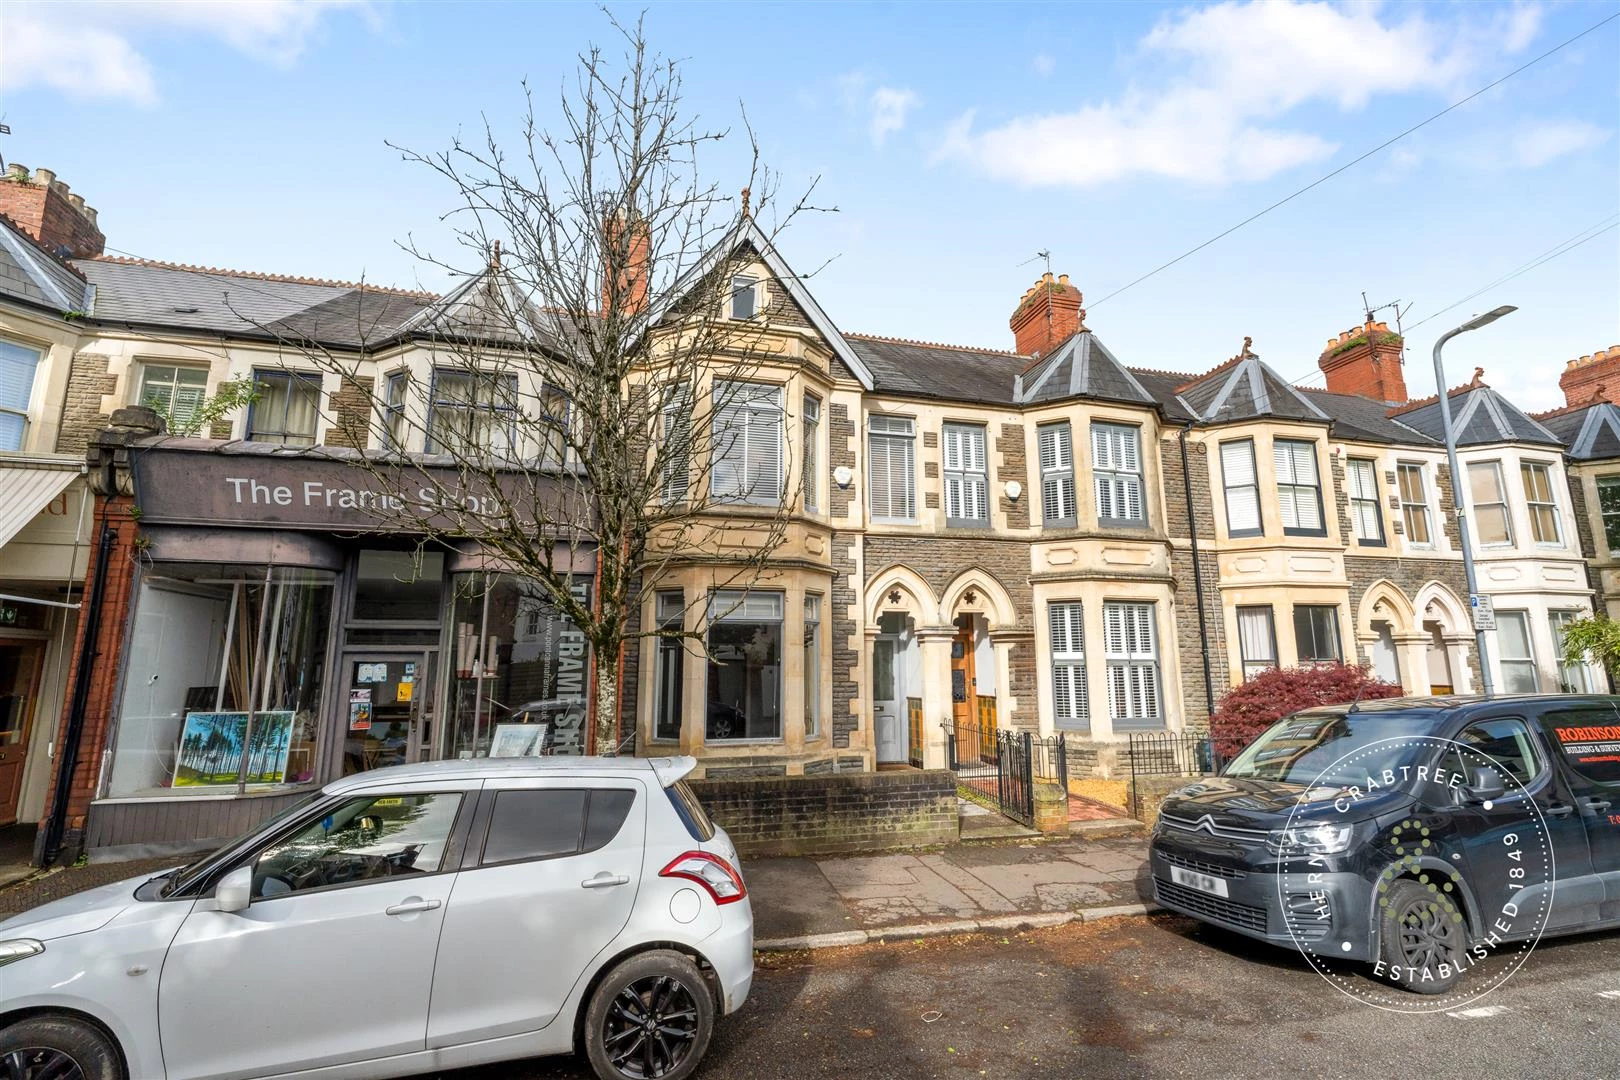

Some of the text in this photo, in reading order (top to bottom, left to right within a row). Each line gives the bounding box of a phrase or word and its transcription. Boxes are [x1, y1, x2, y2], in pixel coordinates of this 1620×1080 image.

[226, 477, 293, 506] The
[303, 481, 406, 511] Frame
[557, 631, 585, 704] FRAME
